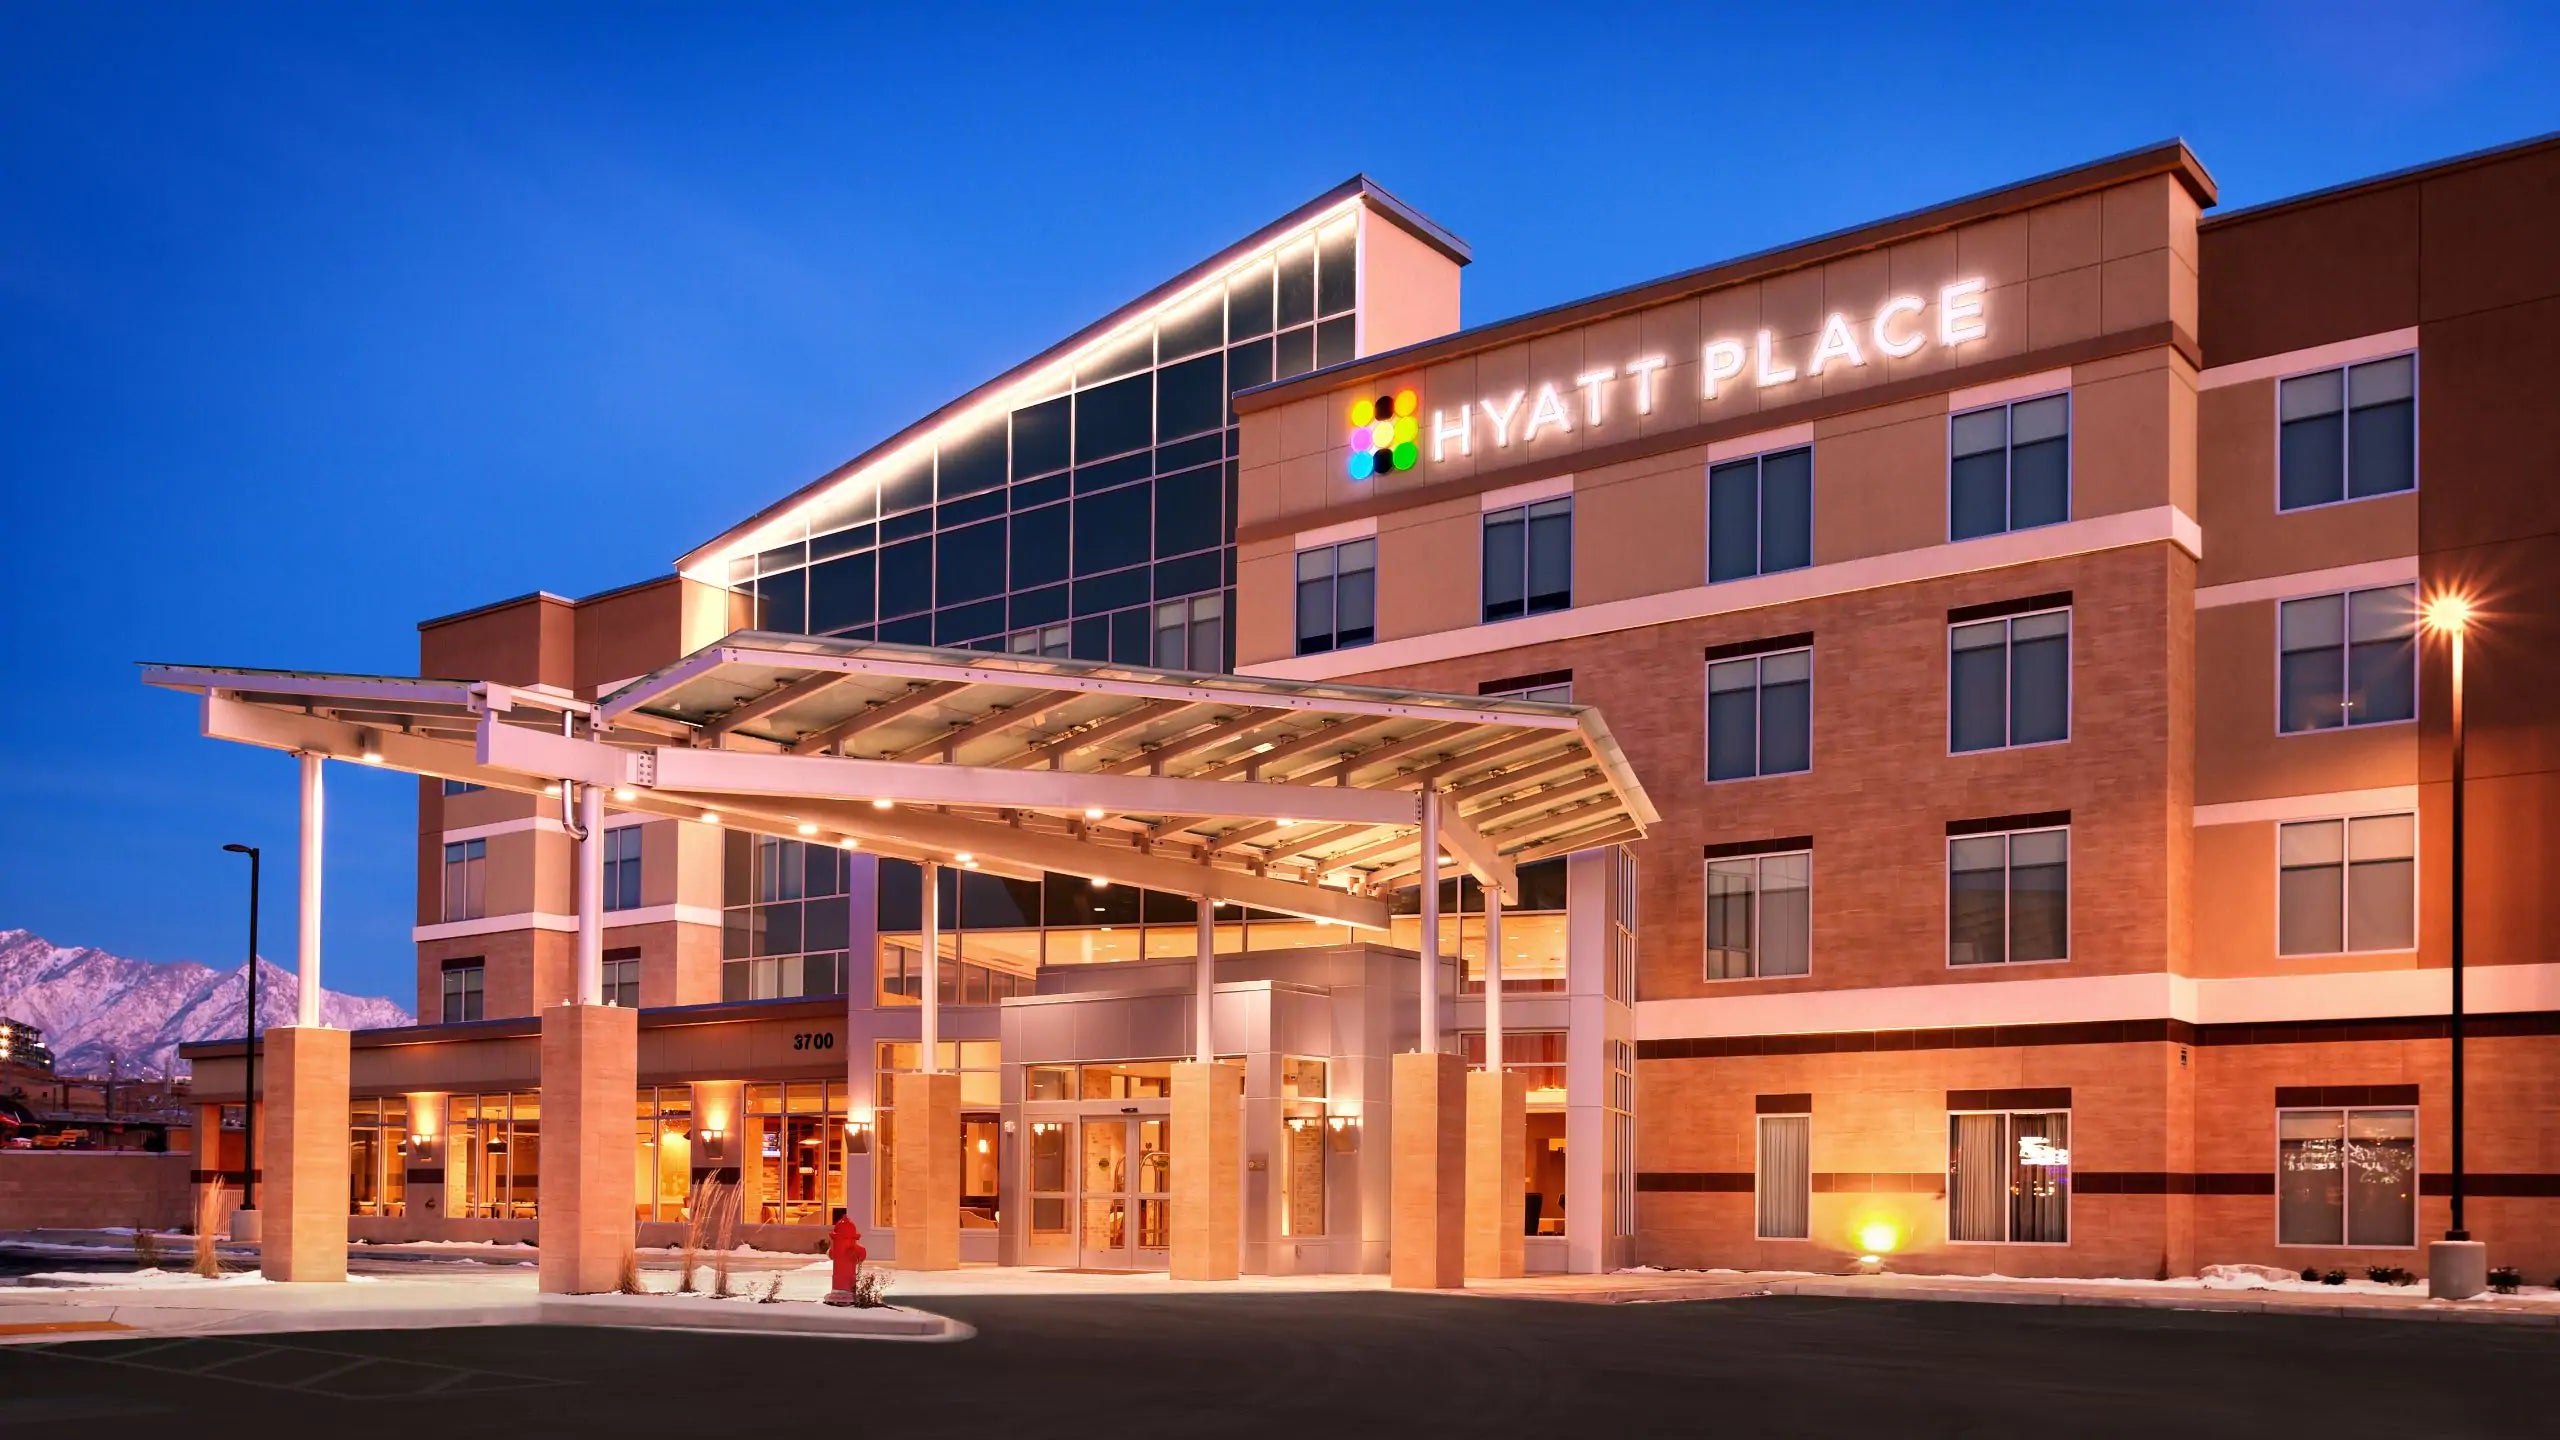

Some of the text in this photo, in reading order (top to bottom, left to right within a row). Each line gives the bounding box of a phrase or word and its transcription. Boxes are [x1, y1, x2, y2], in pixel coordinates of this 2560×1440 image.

[1432, 277, 1987, 462] HYATT PLACE
[794, 1032, 834, 1050] 3700
